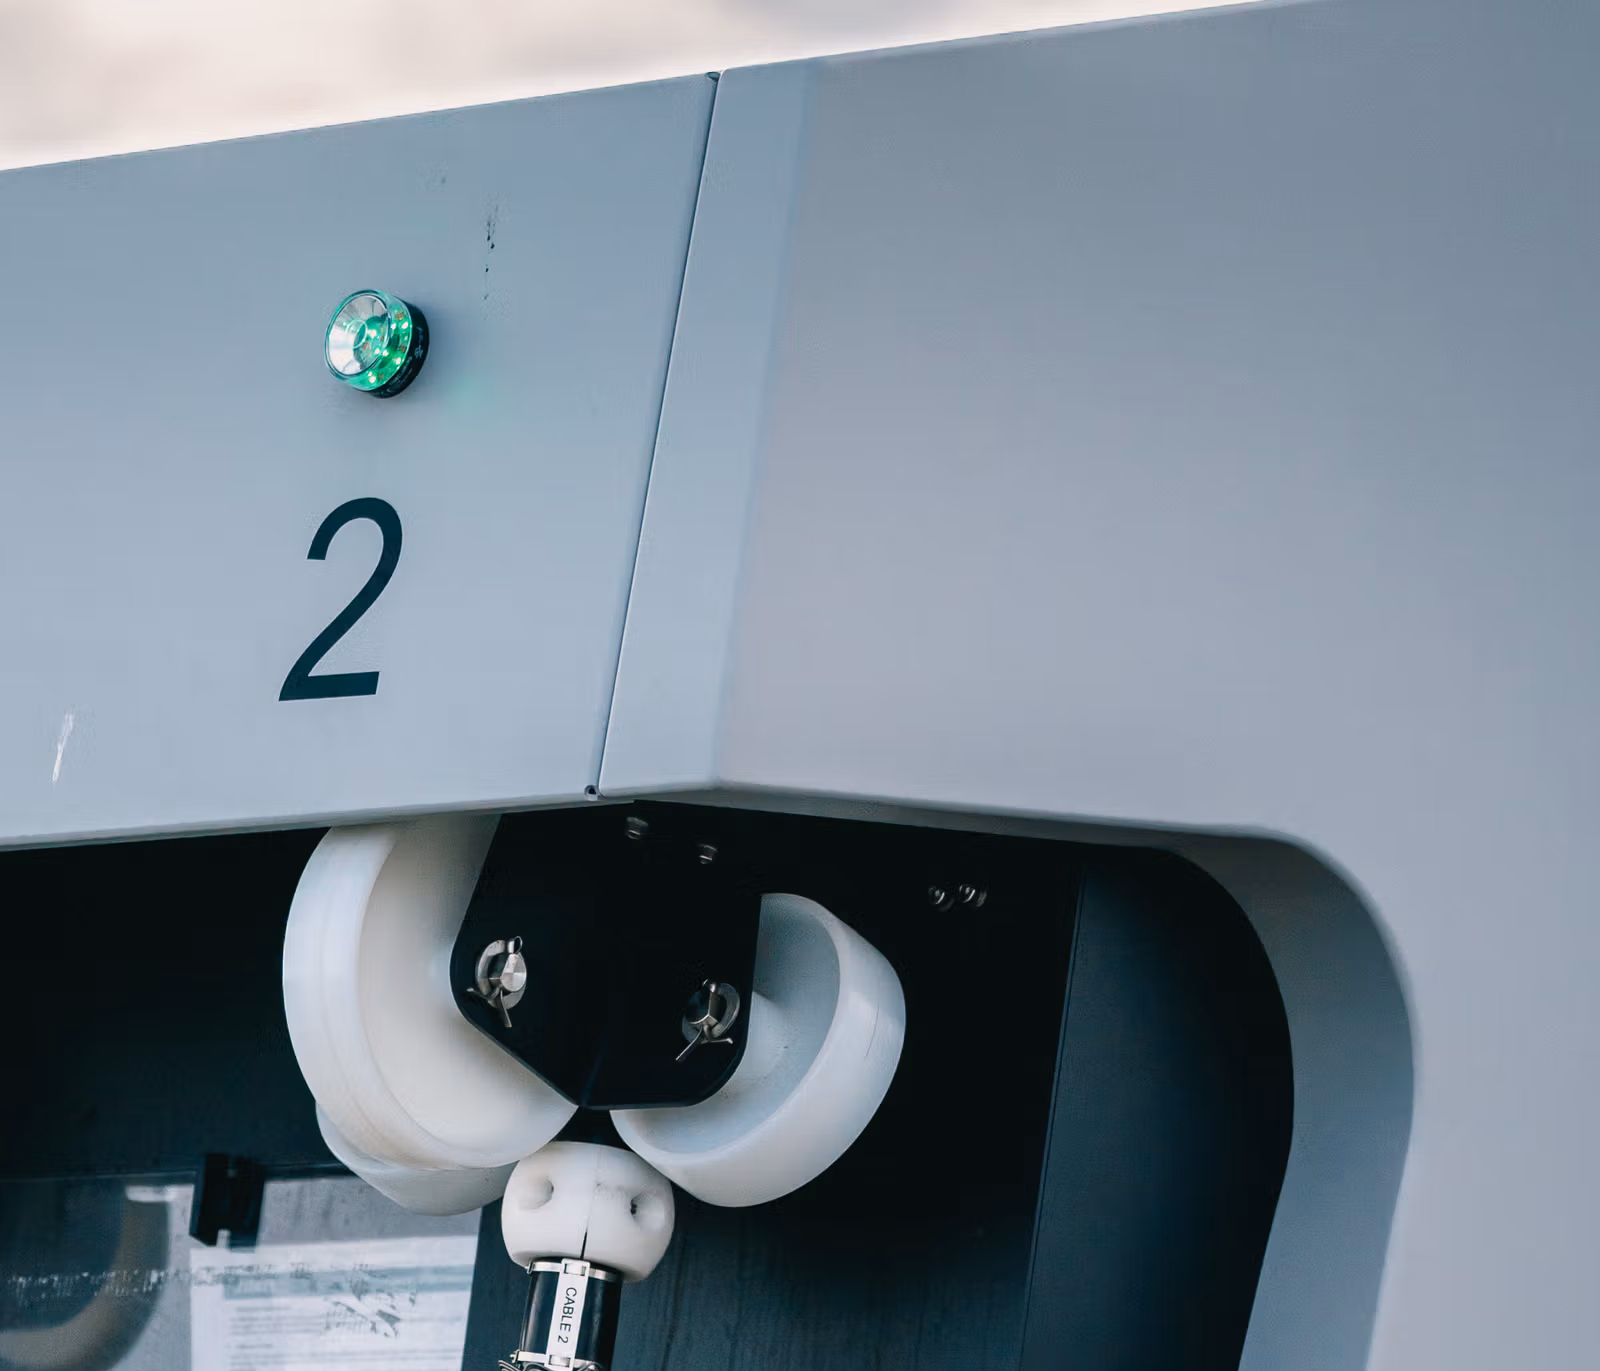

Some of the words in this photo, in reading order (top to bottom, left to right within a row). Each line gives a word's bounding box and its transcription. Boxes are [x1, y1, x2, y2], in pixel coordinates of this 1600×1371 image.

[279, 497, 403, 701] 2
[559, 1287, 577, 1333] CABLE
[557, 1334, 569, 1344] 2
